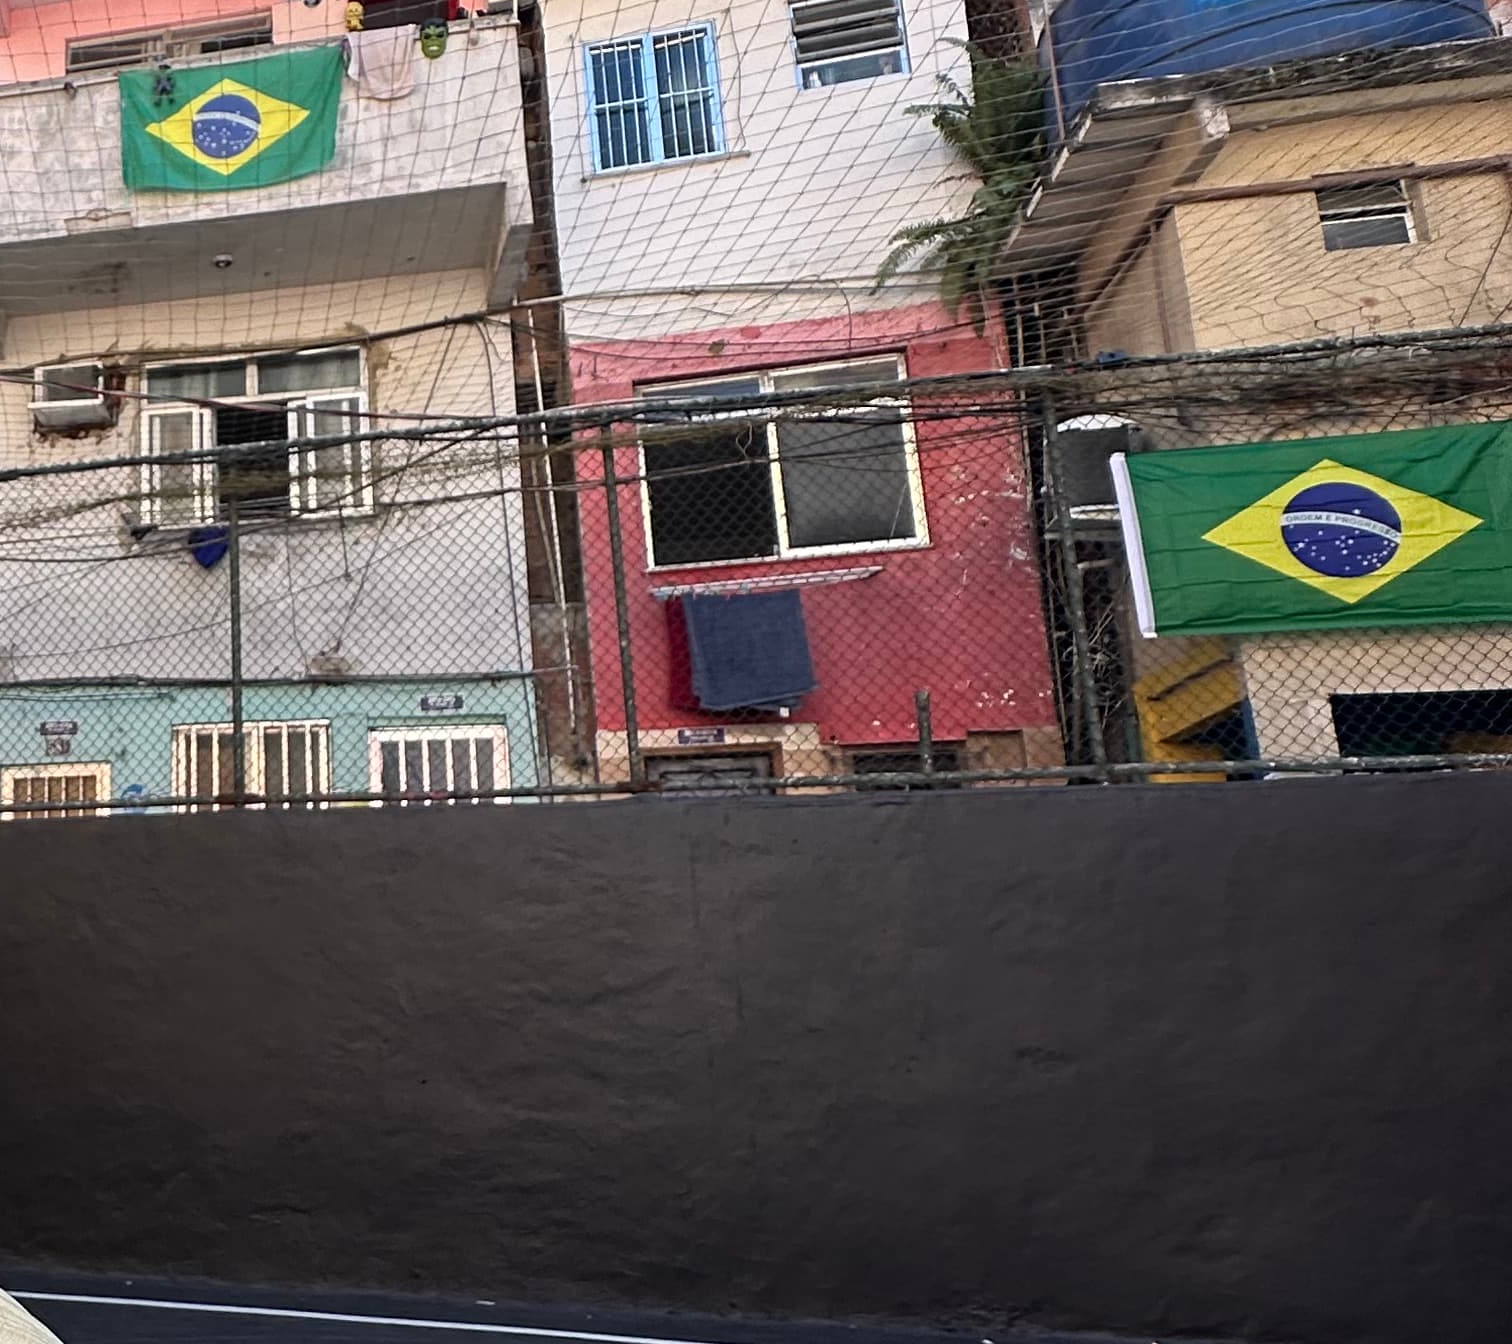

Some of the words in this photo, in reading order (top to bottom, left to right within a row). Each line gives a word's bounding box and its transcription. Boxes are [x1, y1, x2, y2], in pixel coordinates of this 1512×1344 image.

[1285, 513, 1323, 523] ORDEM
[1325, 513, 1333, 522] E
[1334, 515, 1398, 539] PROGRESSO
